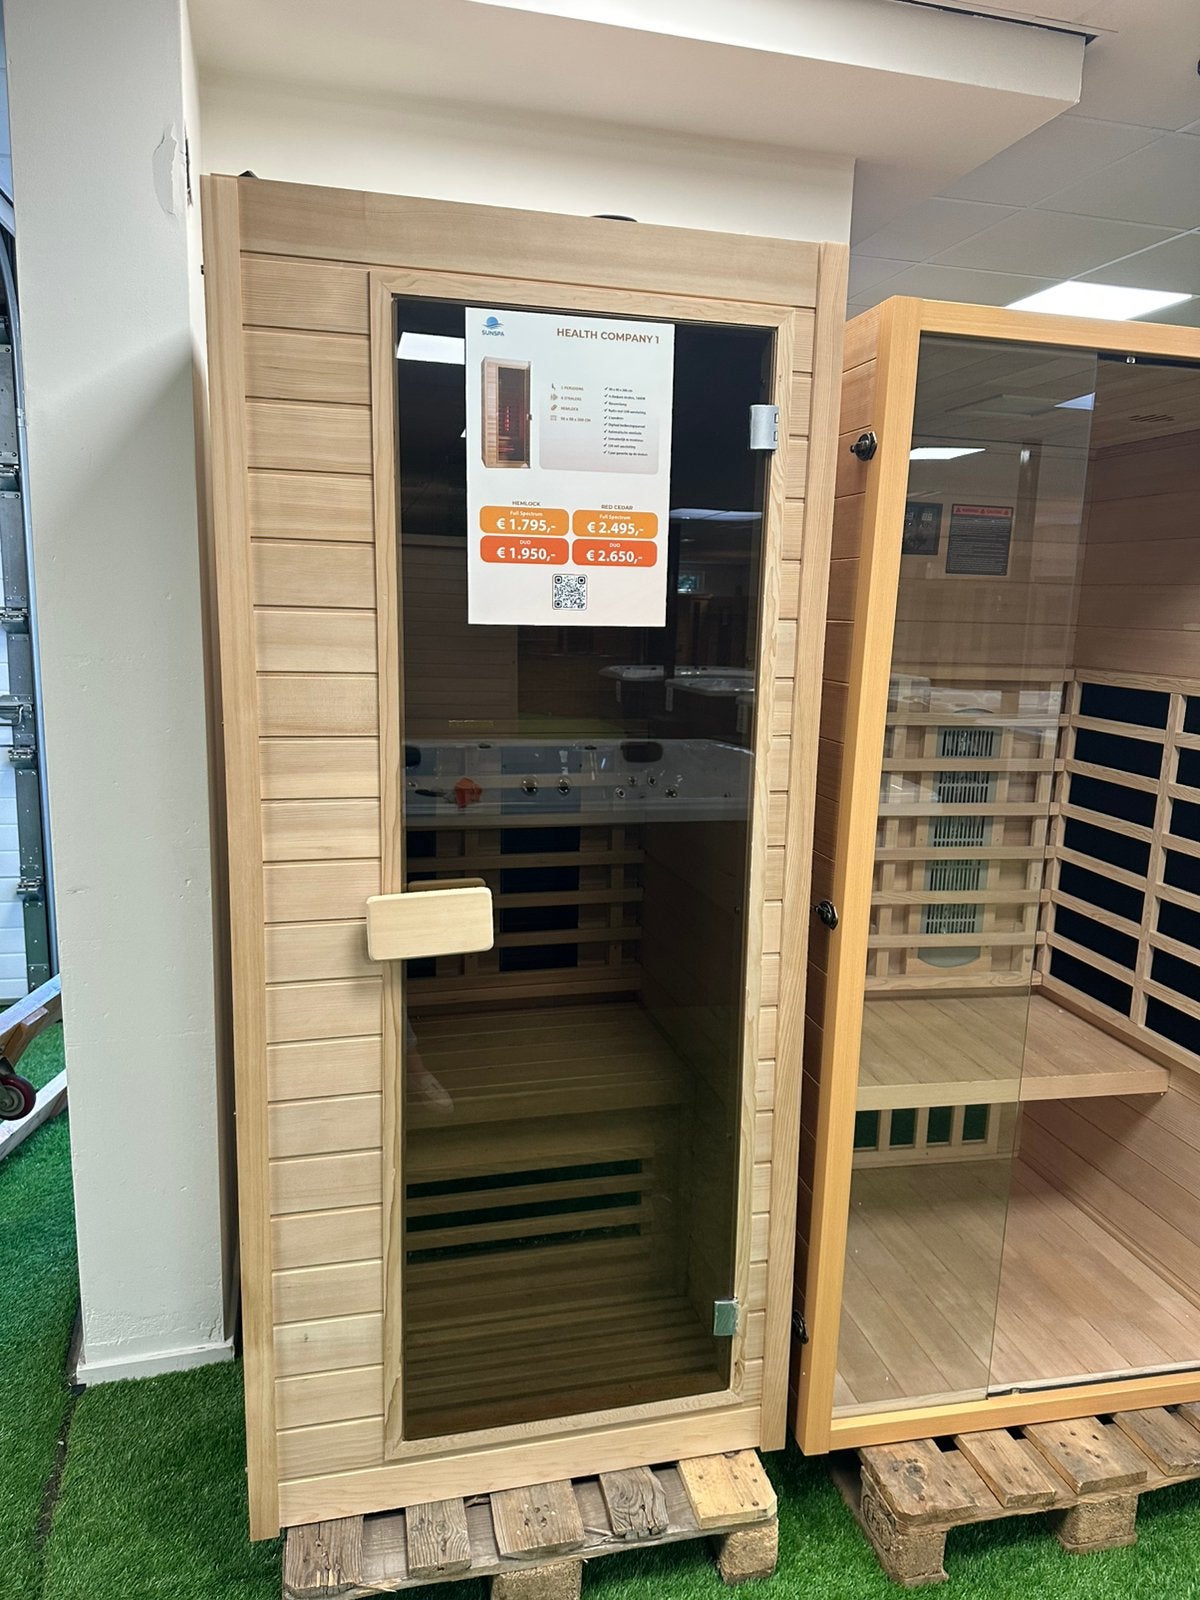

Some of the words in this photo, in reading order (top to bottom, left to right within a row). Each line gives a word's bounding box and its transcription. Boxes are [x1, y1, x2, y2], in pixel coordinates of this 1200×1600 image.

[556, 328, 598, 340] HEALTH
[600, 331, 653, 344] COMPANY
[655, 336, 660, 344] 1
[496, 517, 505, 530] €
[509, 518, 556, 533] 1.795,-
[587, 521, 596, 534] €
[599, 522, 644, 537] 2.495,-
[496, 546, 505, 559] €
[509, 547, 556, 562] 1.950,-
[586, 549, 595, 562] €
[598, 550, 643, 565] 2.650,-
